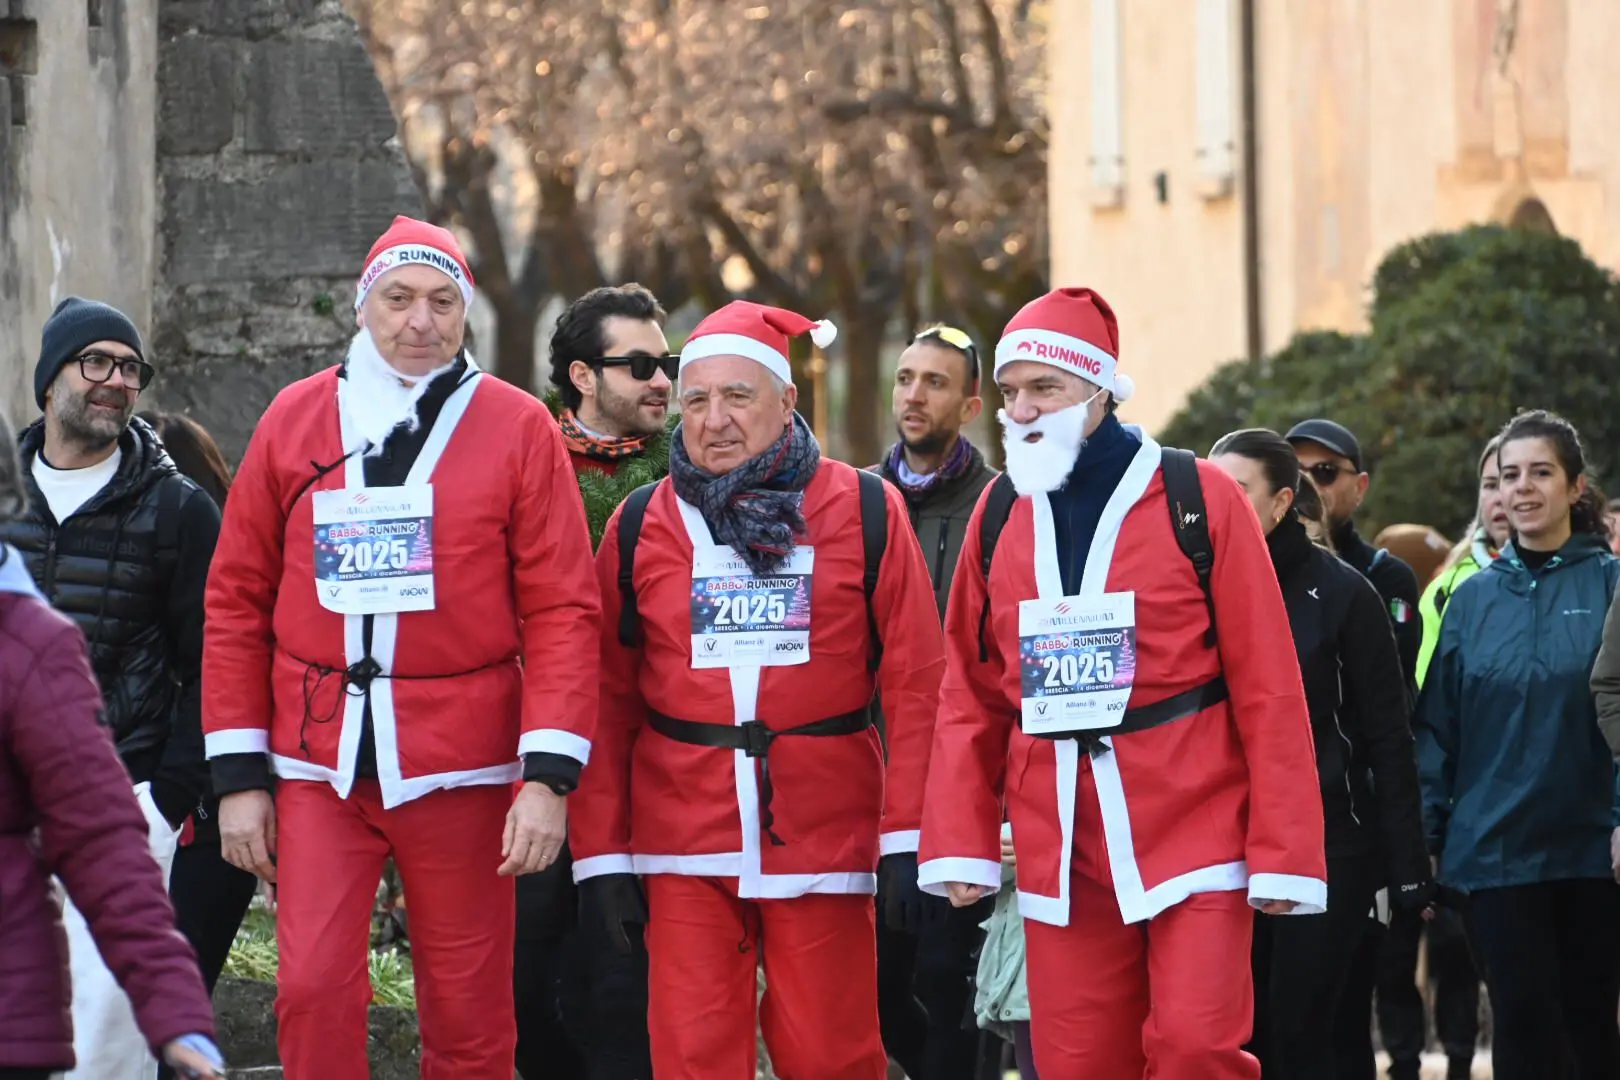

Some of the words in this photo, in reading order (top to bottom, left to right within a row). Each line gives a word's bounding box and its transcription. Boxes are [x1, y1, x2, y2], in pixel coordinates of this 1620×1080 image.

[400, 250, 460, 280] RUNNING
[1036, 343, 1103, 375] RUNNING
[330, 525, 365, 539] BABBO
[369, 523, 416, 536] RUNNING
[338, 539, 408, 573] 2025
[707, 579, 744, 591] BABBO
[746, 578, 797, 590] RUNNING
[713, 593, 786, 626] 2025
[755, 623, 786, 631] dicembre
[775, 642, 804, 652] WOW
[1034, 636, 1069, 651] BABBO
[1073, 633, 1121, 648] RUNNING
[1043, 651, 1114, 688] 2025
[1085, 683, 1115, 691] dicembre
[1065, 700, 1087, 709] Allianz
[1107, 701, 1126, 712] WO
